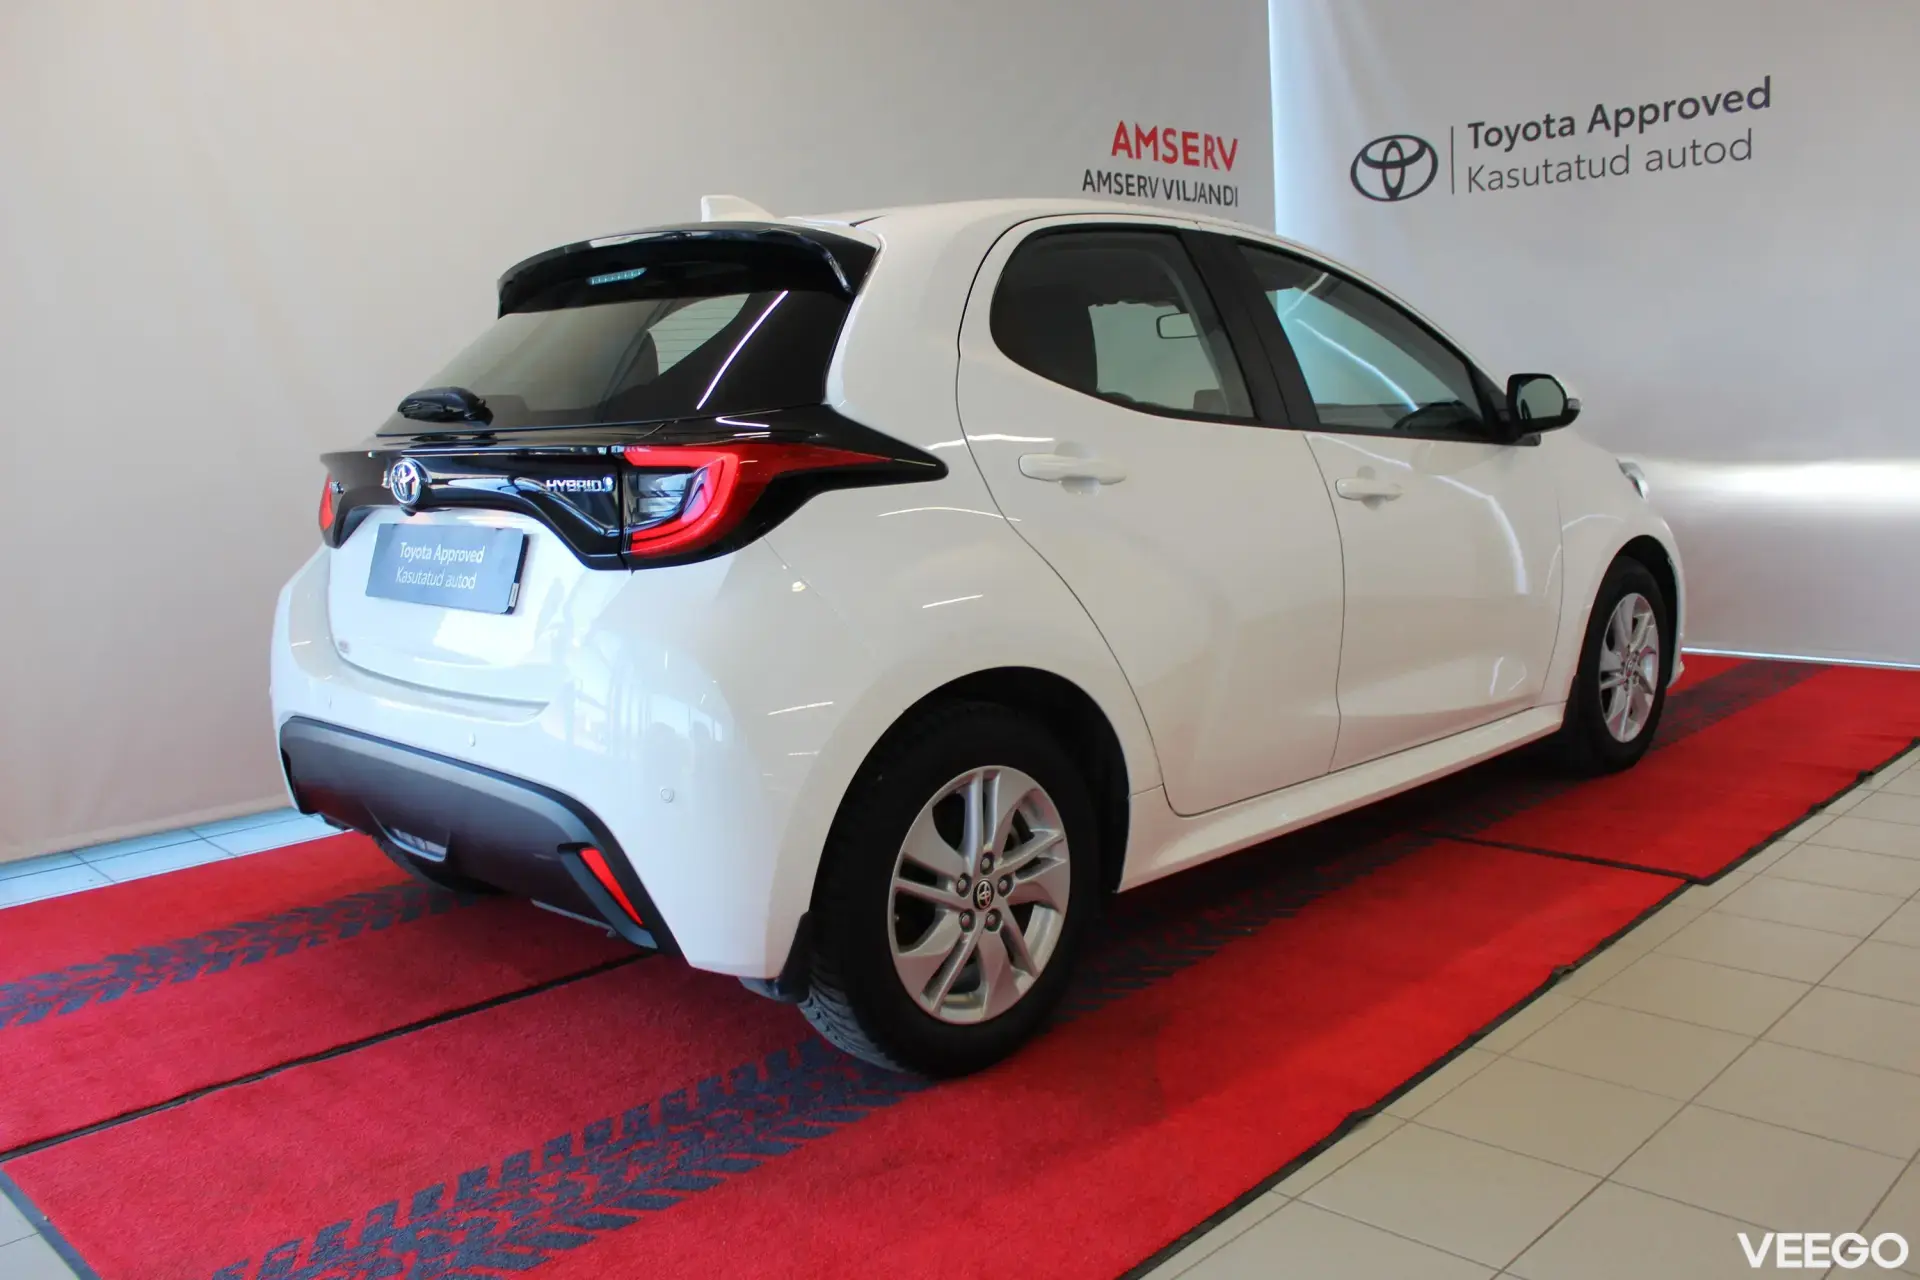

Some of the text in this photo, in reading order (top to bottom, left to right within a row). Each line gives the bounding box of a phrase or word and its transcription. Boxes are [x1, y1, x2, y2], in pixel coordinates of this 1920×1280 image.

[1467, 75, 1771, 152] Toyota Approved
[1111, 120, 1239, 172] AMSERV
[1467, 128, 1753, 193] Kasutatud autod
[1082, 169, 1239, 208] AMSERV VILJANDI
[546, 479, 602, 492] HYBRID
[400, 542, 485, 566] Toyota Approved
[396, 567, 477, 590] Kasutatud autod
